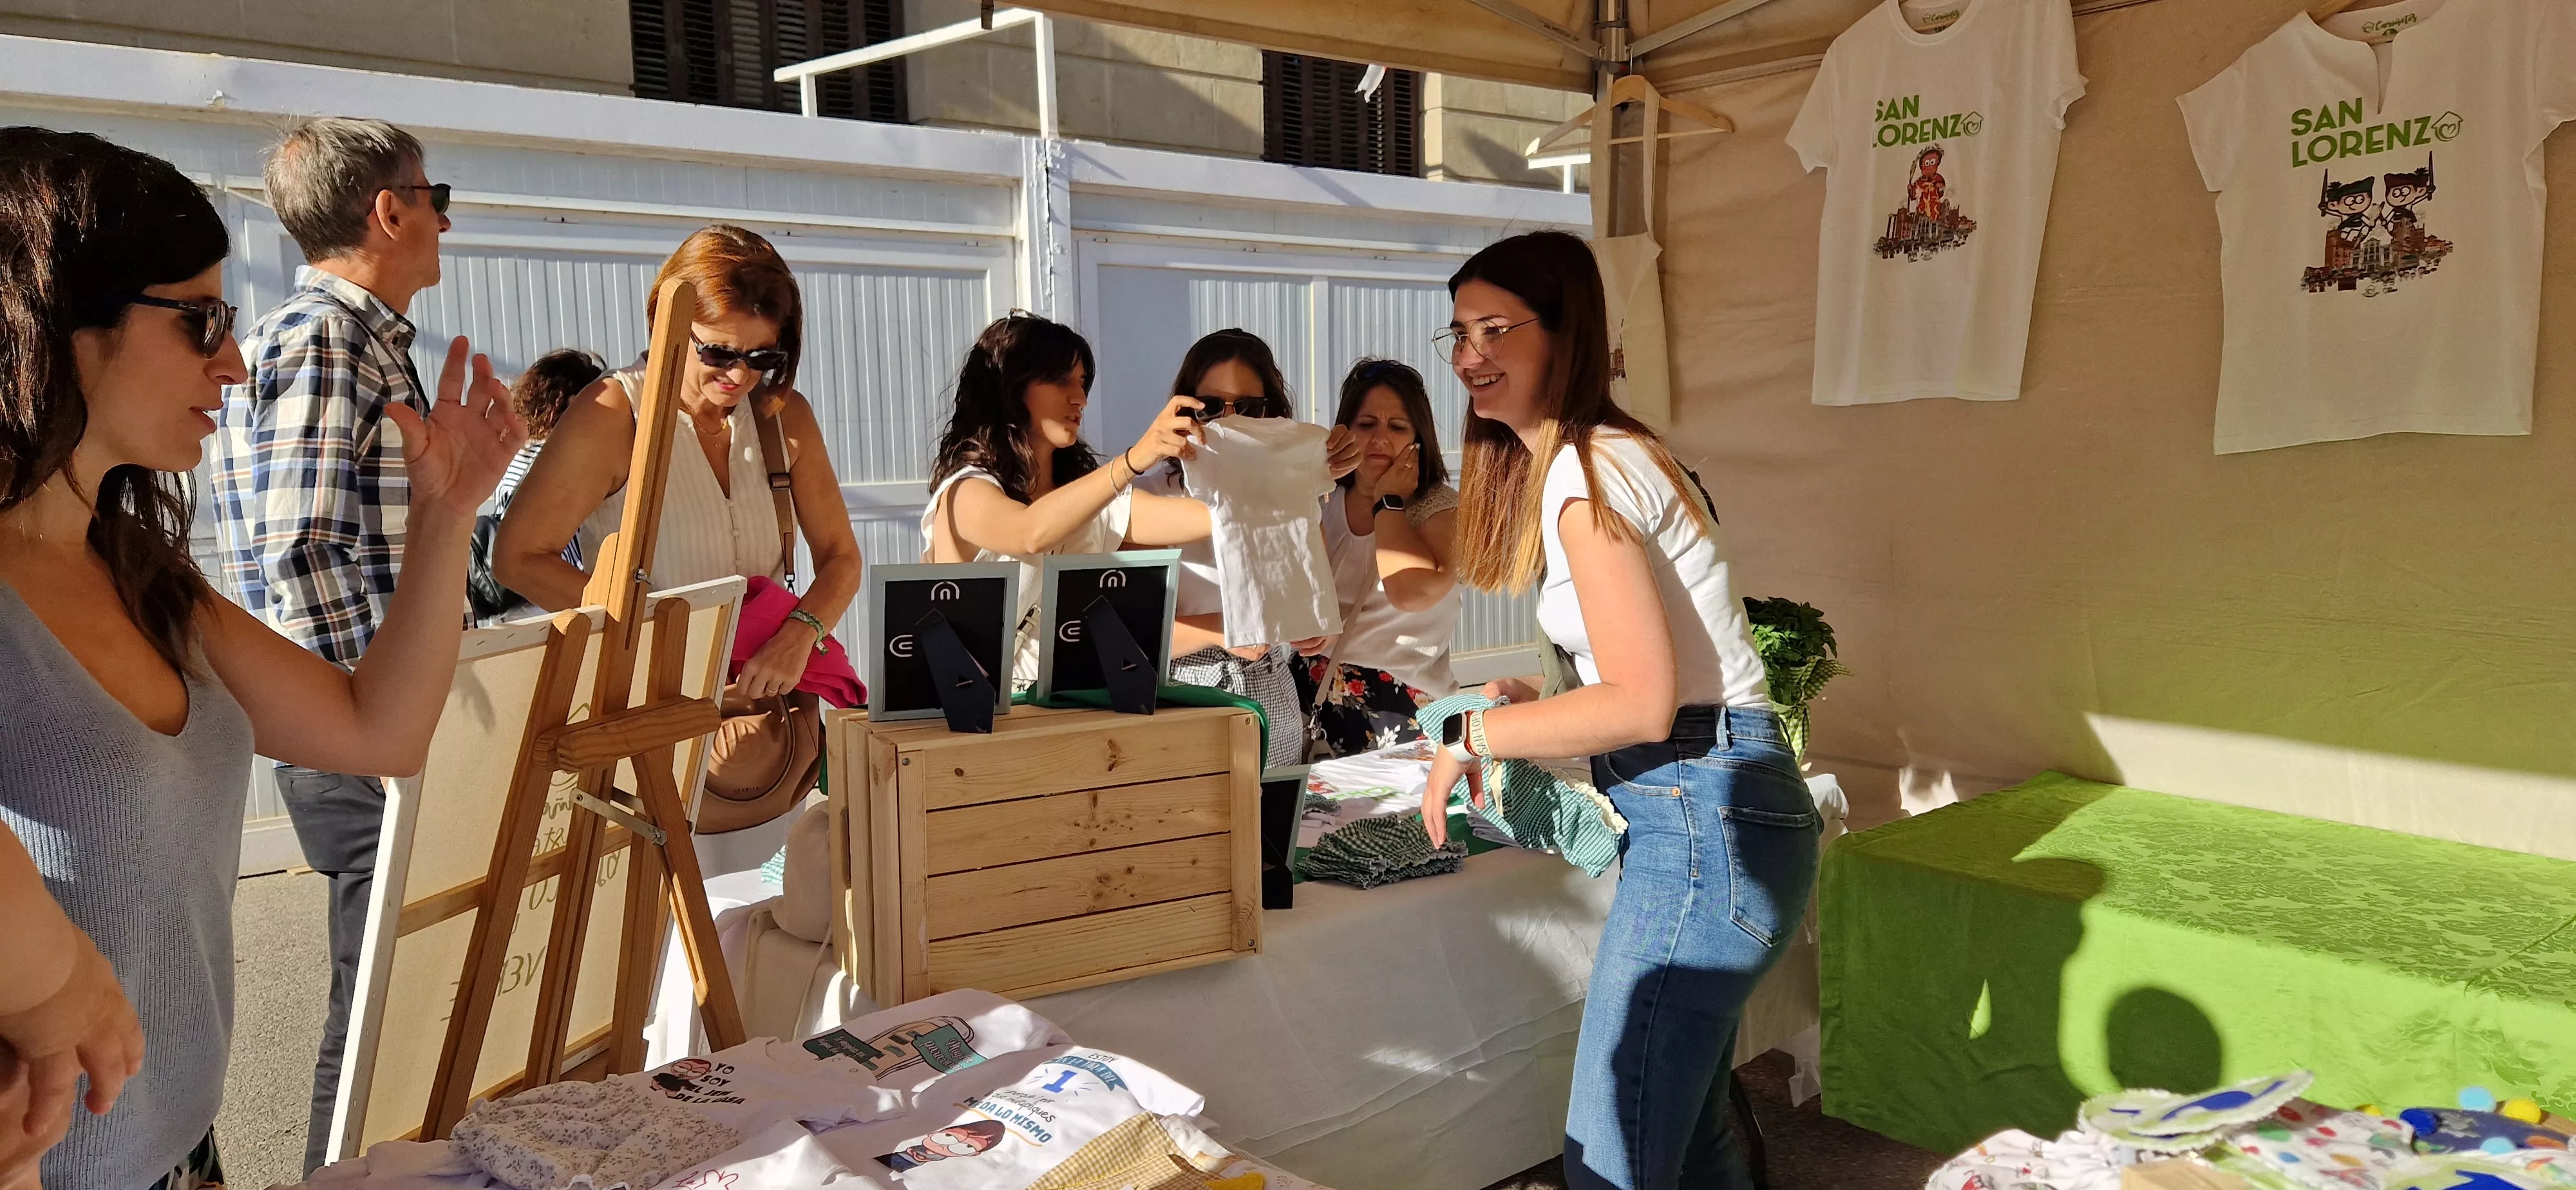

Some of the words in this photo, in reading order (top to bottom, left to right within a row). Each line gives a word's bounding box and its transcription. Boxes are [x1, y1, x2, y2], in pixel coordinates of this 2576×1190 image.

[2291, 97, 2363, 137] SAN
[1088, 1053, 1119, 1063] ESTOY
[714, 1062, 735, 1075] YO
[700, 1075, 731, 1086] SOY
[1041, 1070, 1079, 1093] 1
[676, 1093, 693, 1102] DE
[978, 1102, 997, 1113] DA
[994, 1106, 1014, 1120] LO
[1009, 1113, 1053, 1144] MISMO
